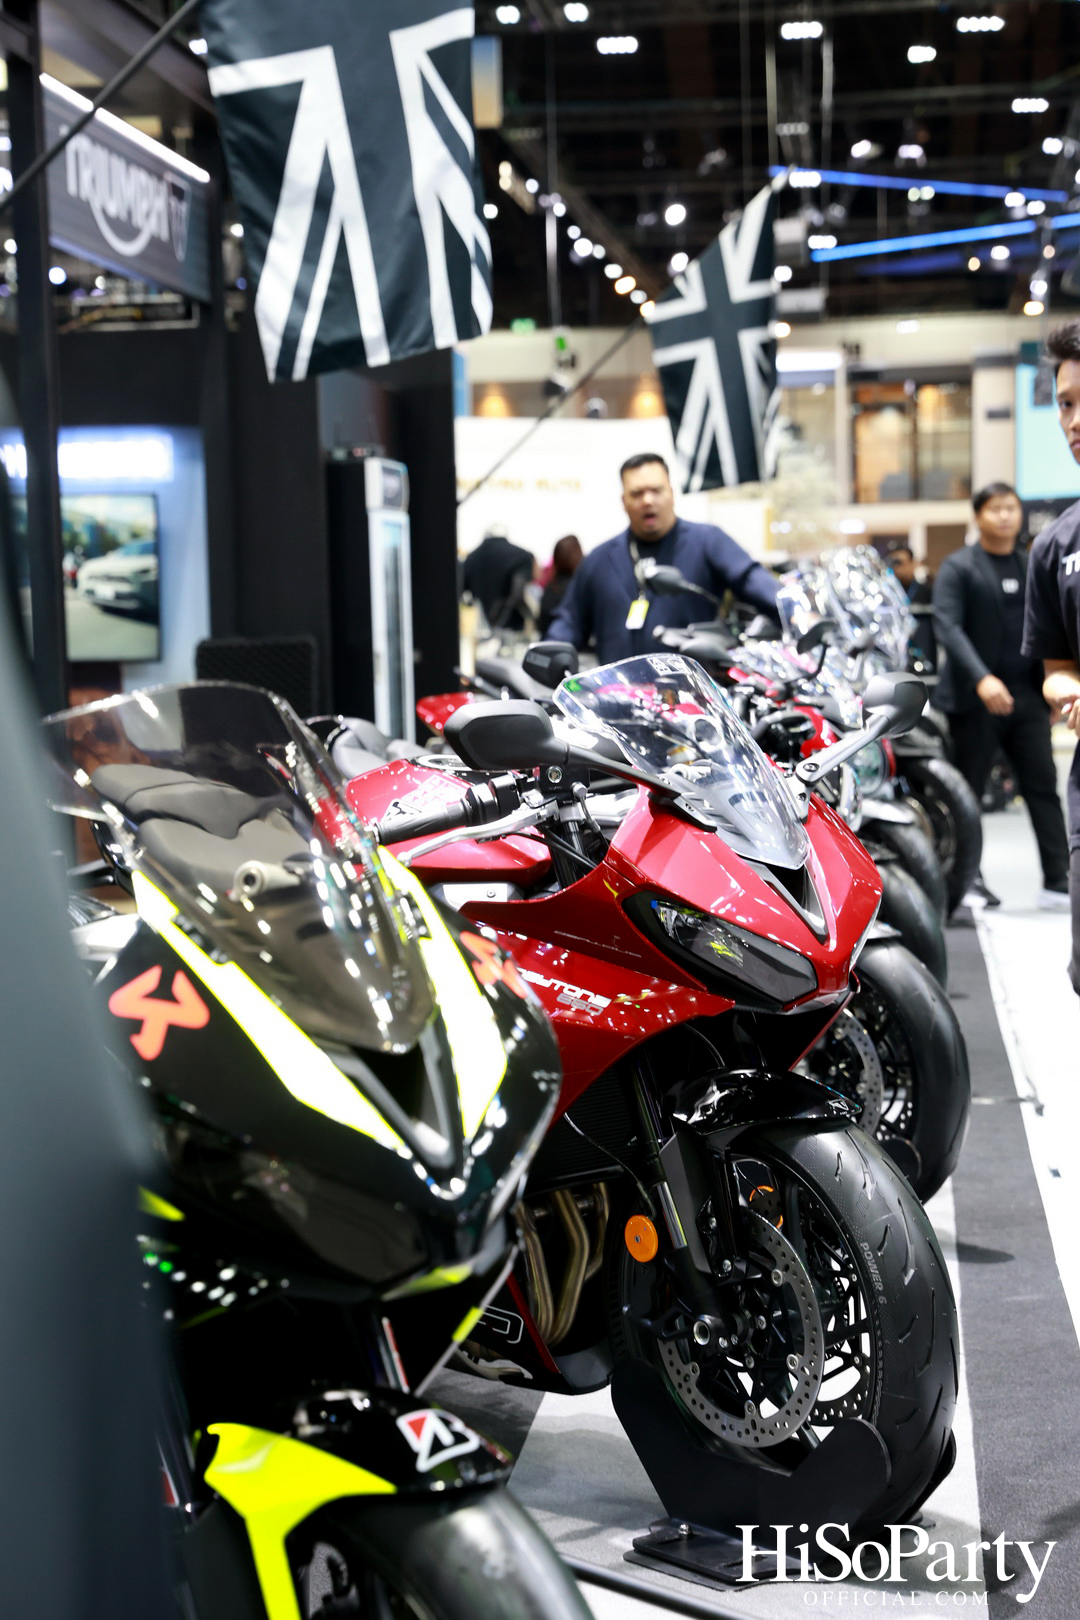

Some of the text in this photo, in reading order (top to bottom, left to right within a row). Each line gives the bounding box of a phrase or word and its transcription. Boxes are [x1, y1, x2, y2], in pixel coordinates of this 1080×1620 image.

[556, 992, 604, 1016] 660
[860, 1242, 888, 1305] POWER 6
